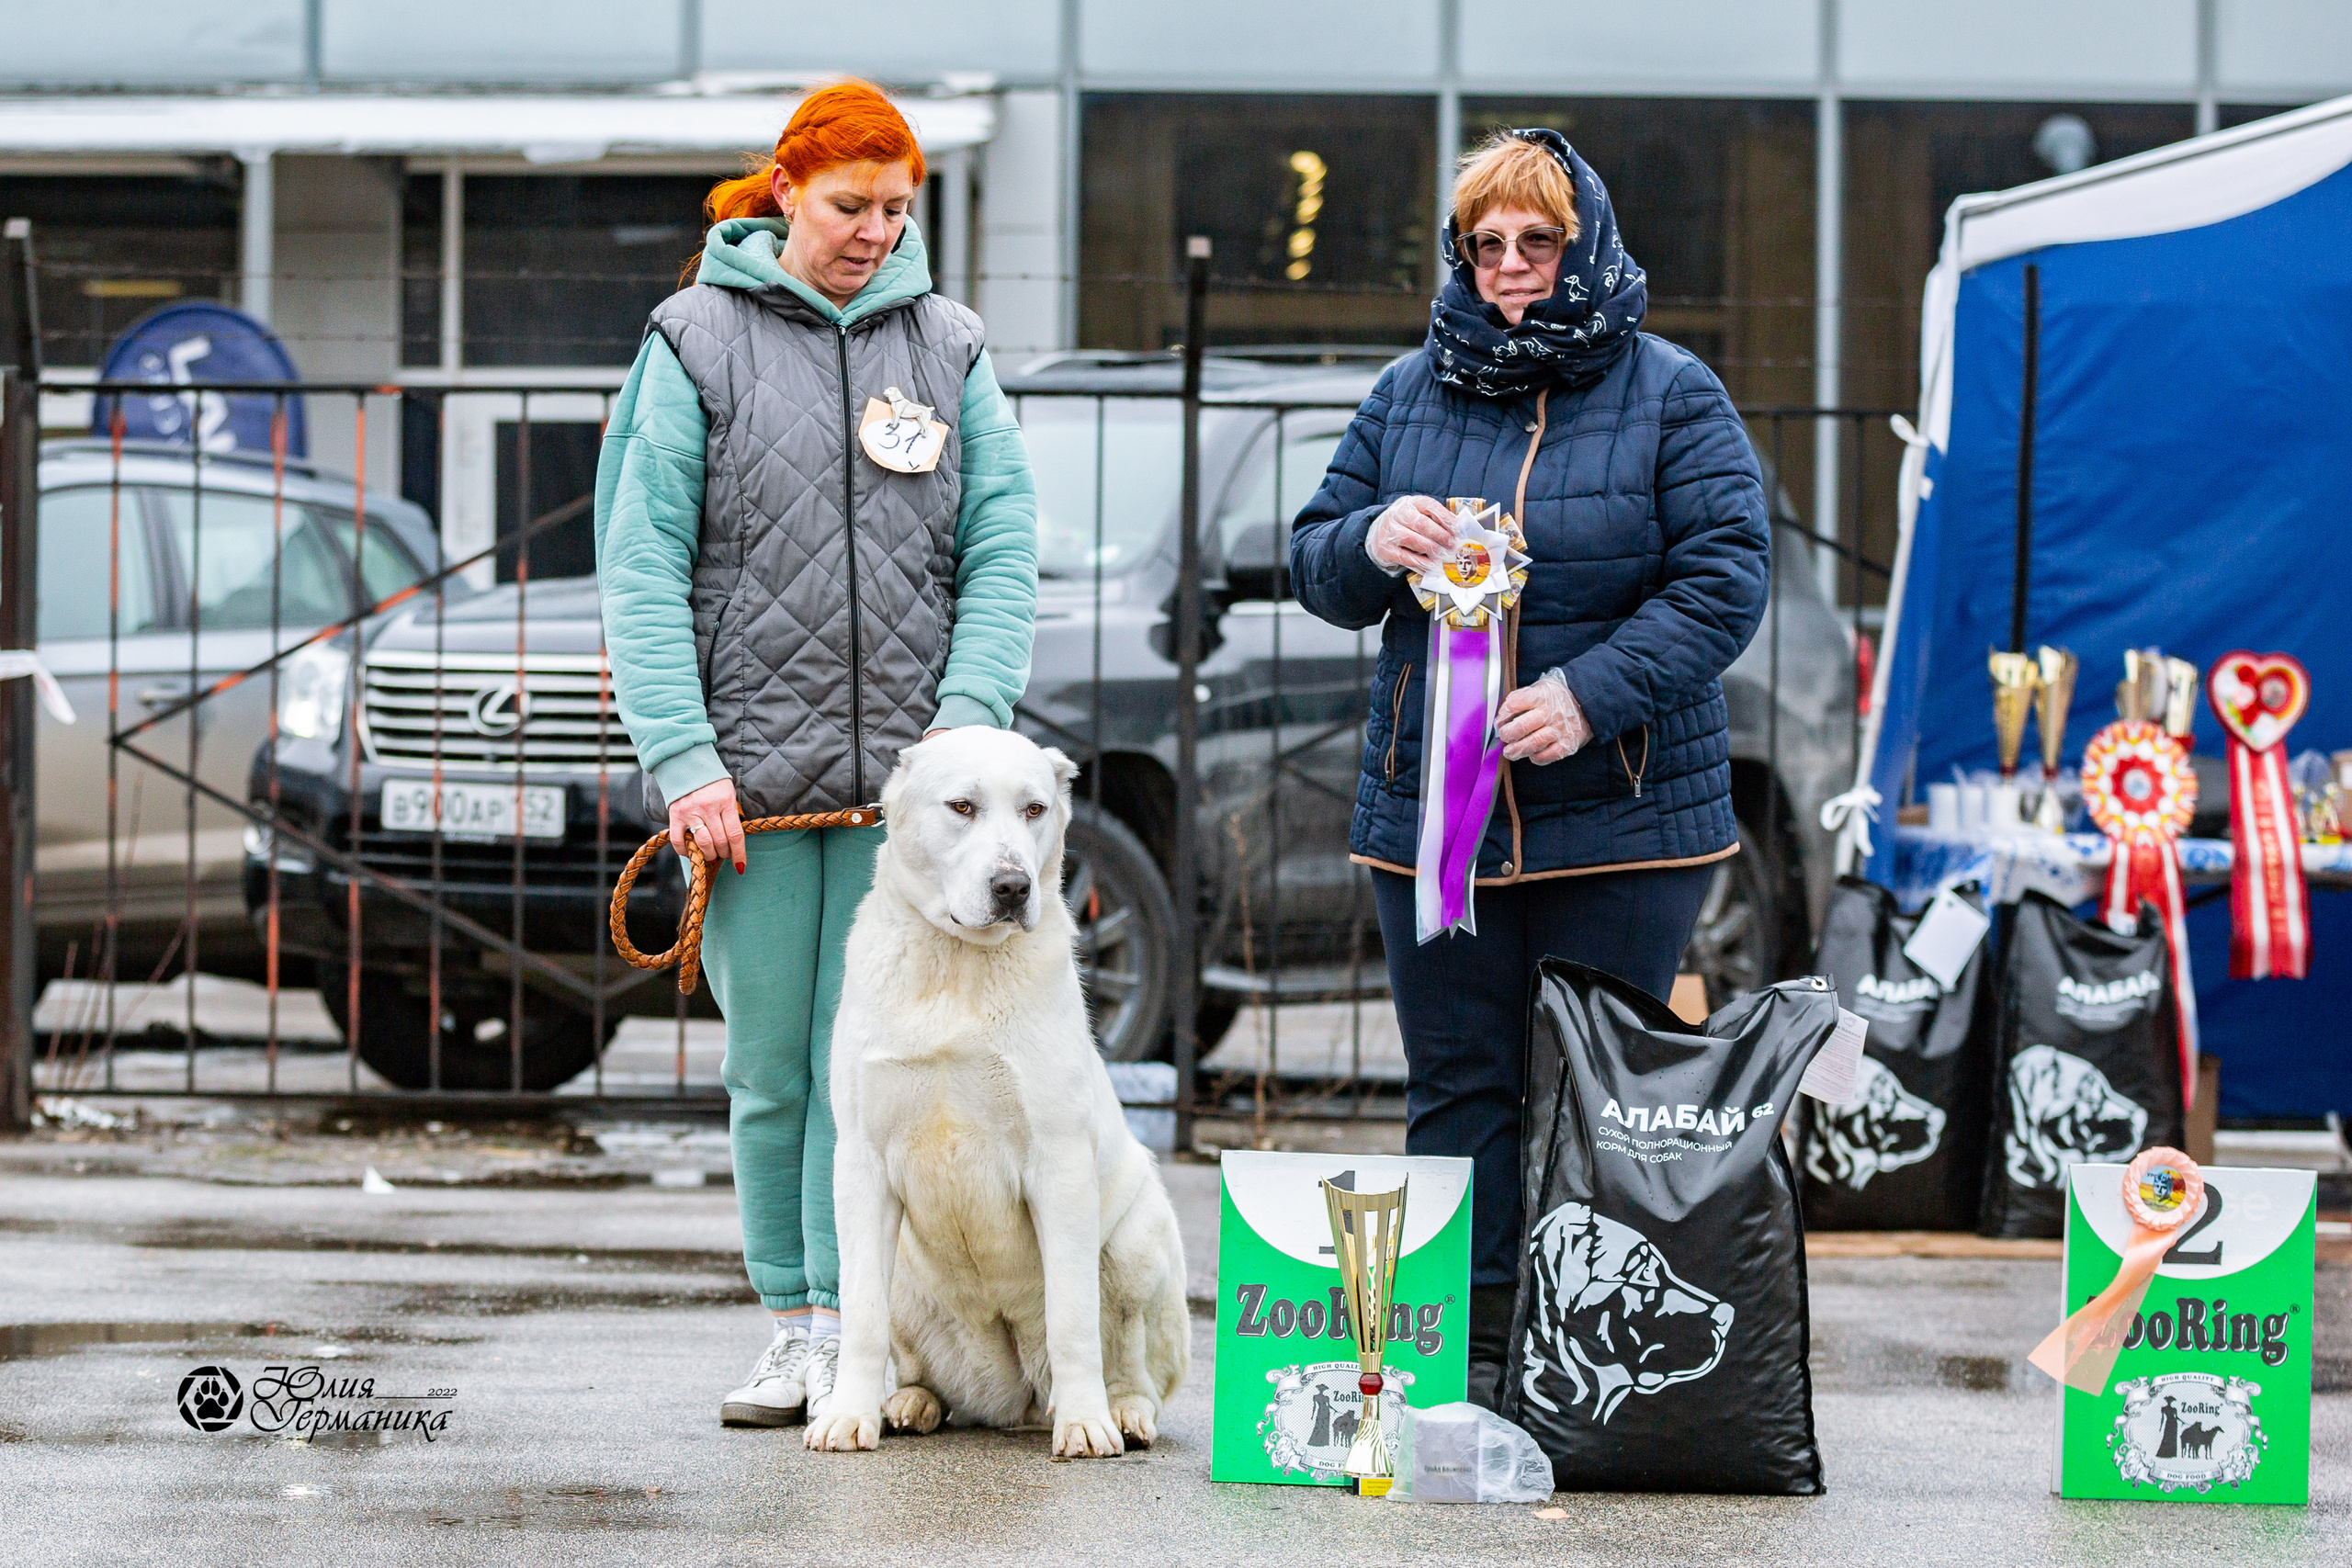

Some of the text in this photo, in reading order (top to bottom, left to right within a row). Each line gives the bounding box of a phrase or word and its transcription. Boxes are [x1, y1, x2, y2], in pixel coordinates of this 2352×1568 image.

[1600, 1098, 1775, 1136] АЛАБАЙ 62
[1596, 1140, 1683, 1164] КОРМ ДЛЯ СОБАК
[1598, 1126, 1733, 1154] СУХОЙ ПОЛНОРАЦИОННЫЙ
[2162, 1181, 2223, 1265] 2
[1236, 1283, 1444, 1357] ZooRng
[2182, 1374, 2215, 1382] QUALITY
[1333, 1391, 1364, 1403] ZooRi
[2181, 1402, 2220, 1416] ZooRing
